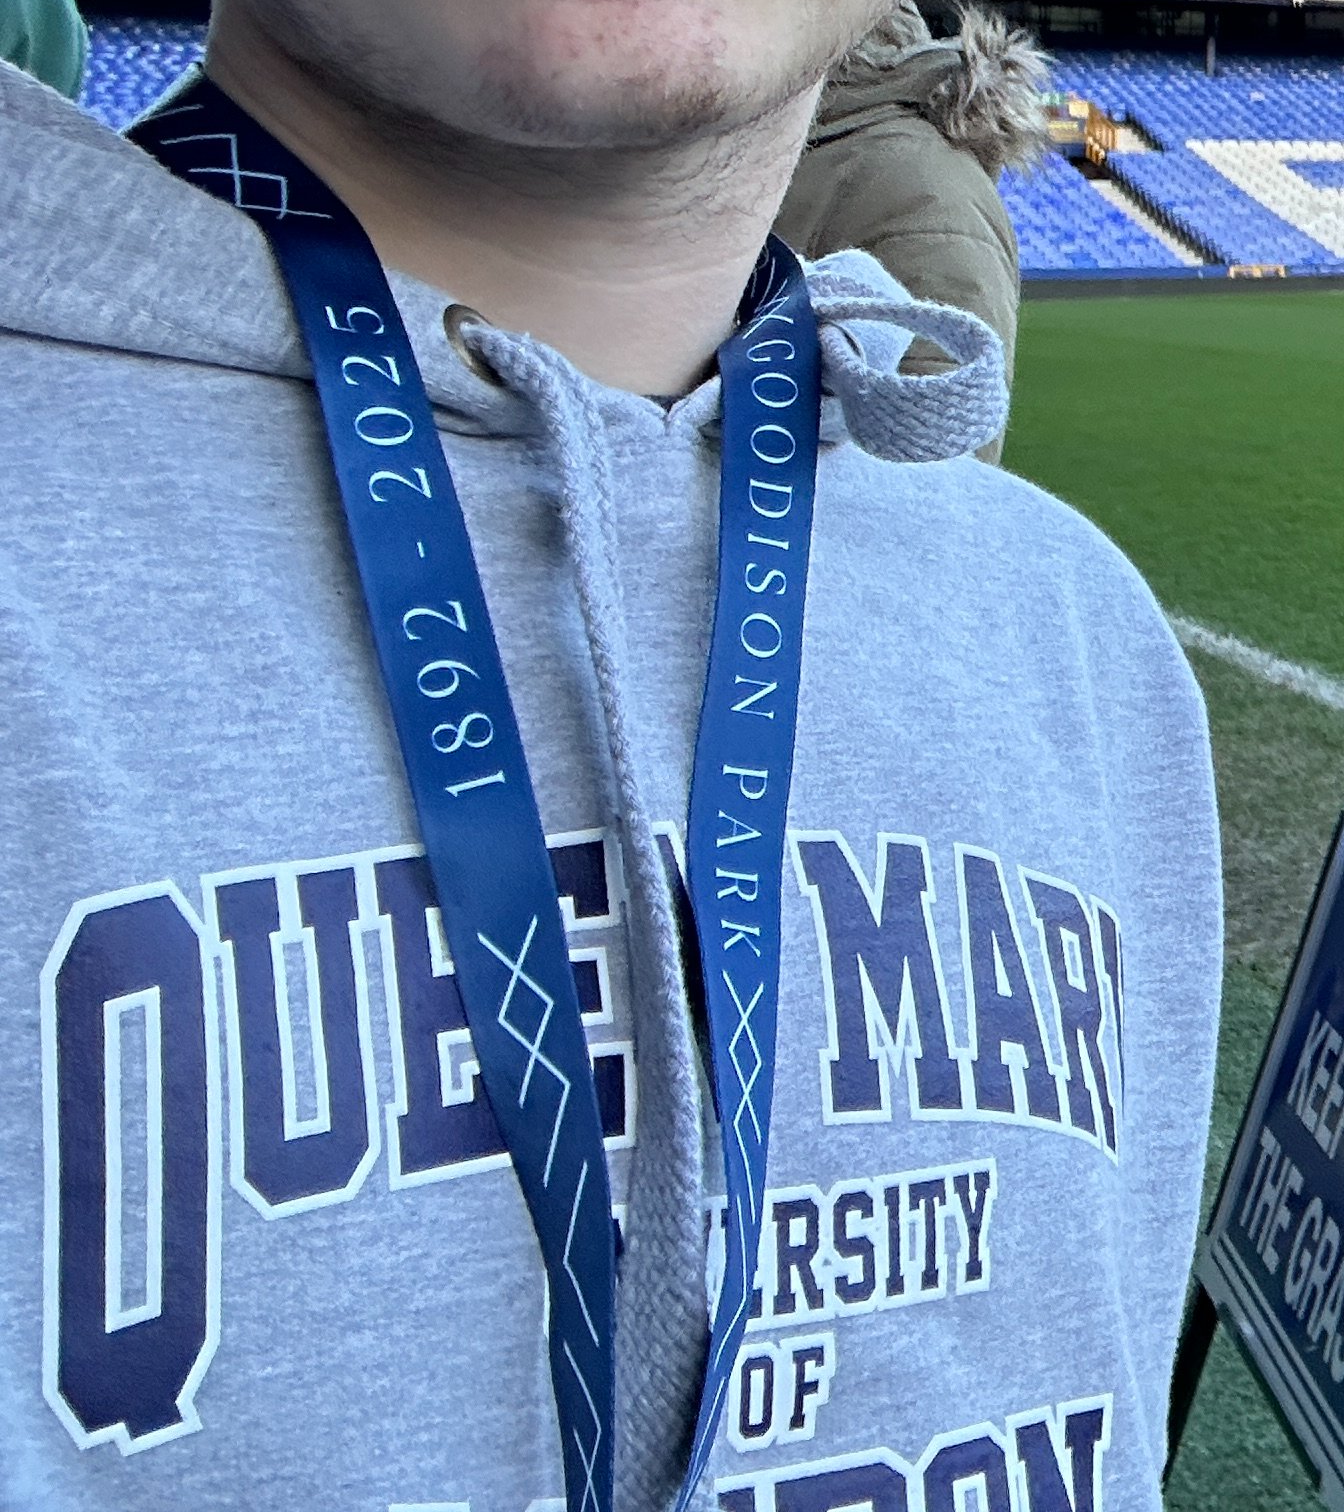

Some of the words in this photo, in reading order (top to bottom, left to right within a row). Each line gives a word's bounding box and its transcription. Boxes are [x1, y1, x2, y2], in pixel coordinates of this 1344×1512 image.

[325, 304, 433, 504] 2025
[730, 338, 799, 721] GOODISON
[402, 599, 506, 798] 1892
[715, 763, 770, 962] PARK
[1239, 1126, 1302, 1276] THE
[727, 1333, 836, 1453] OF
